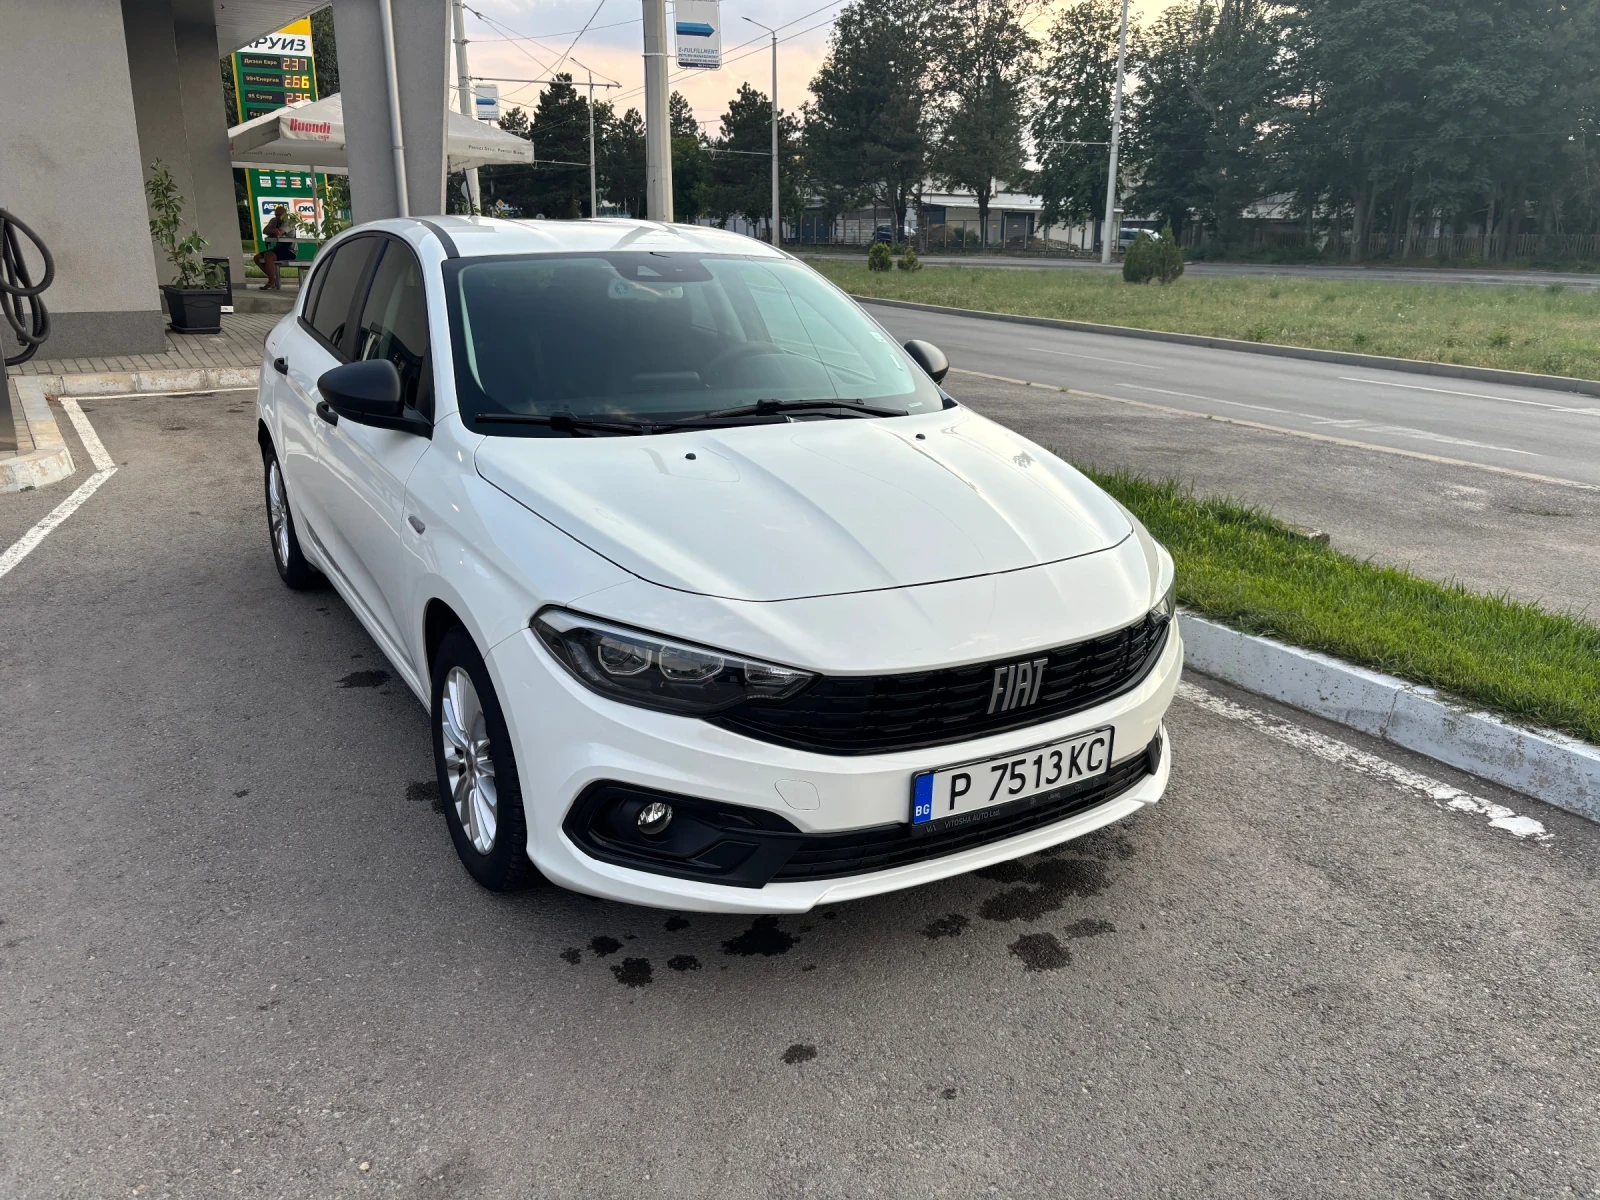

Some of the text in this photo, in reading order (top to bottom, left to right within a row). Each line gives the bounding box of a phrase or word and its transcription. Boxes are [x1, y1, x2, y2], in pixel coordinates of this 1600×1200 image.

[249, 37, 306, 51] РУИЗ
[289, 118, 331, 134] Buondi
[987, 657, 1048, 714] FIAT
[949, 772, 971, 811] P
[915, 804, 930, 817] BG
[944, 815, 972, 828] VITOSHA
[972, 811, 989, 822] AUTO
